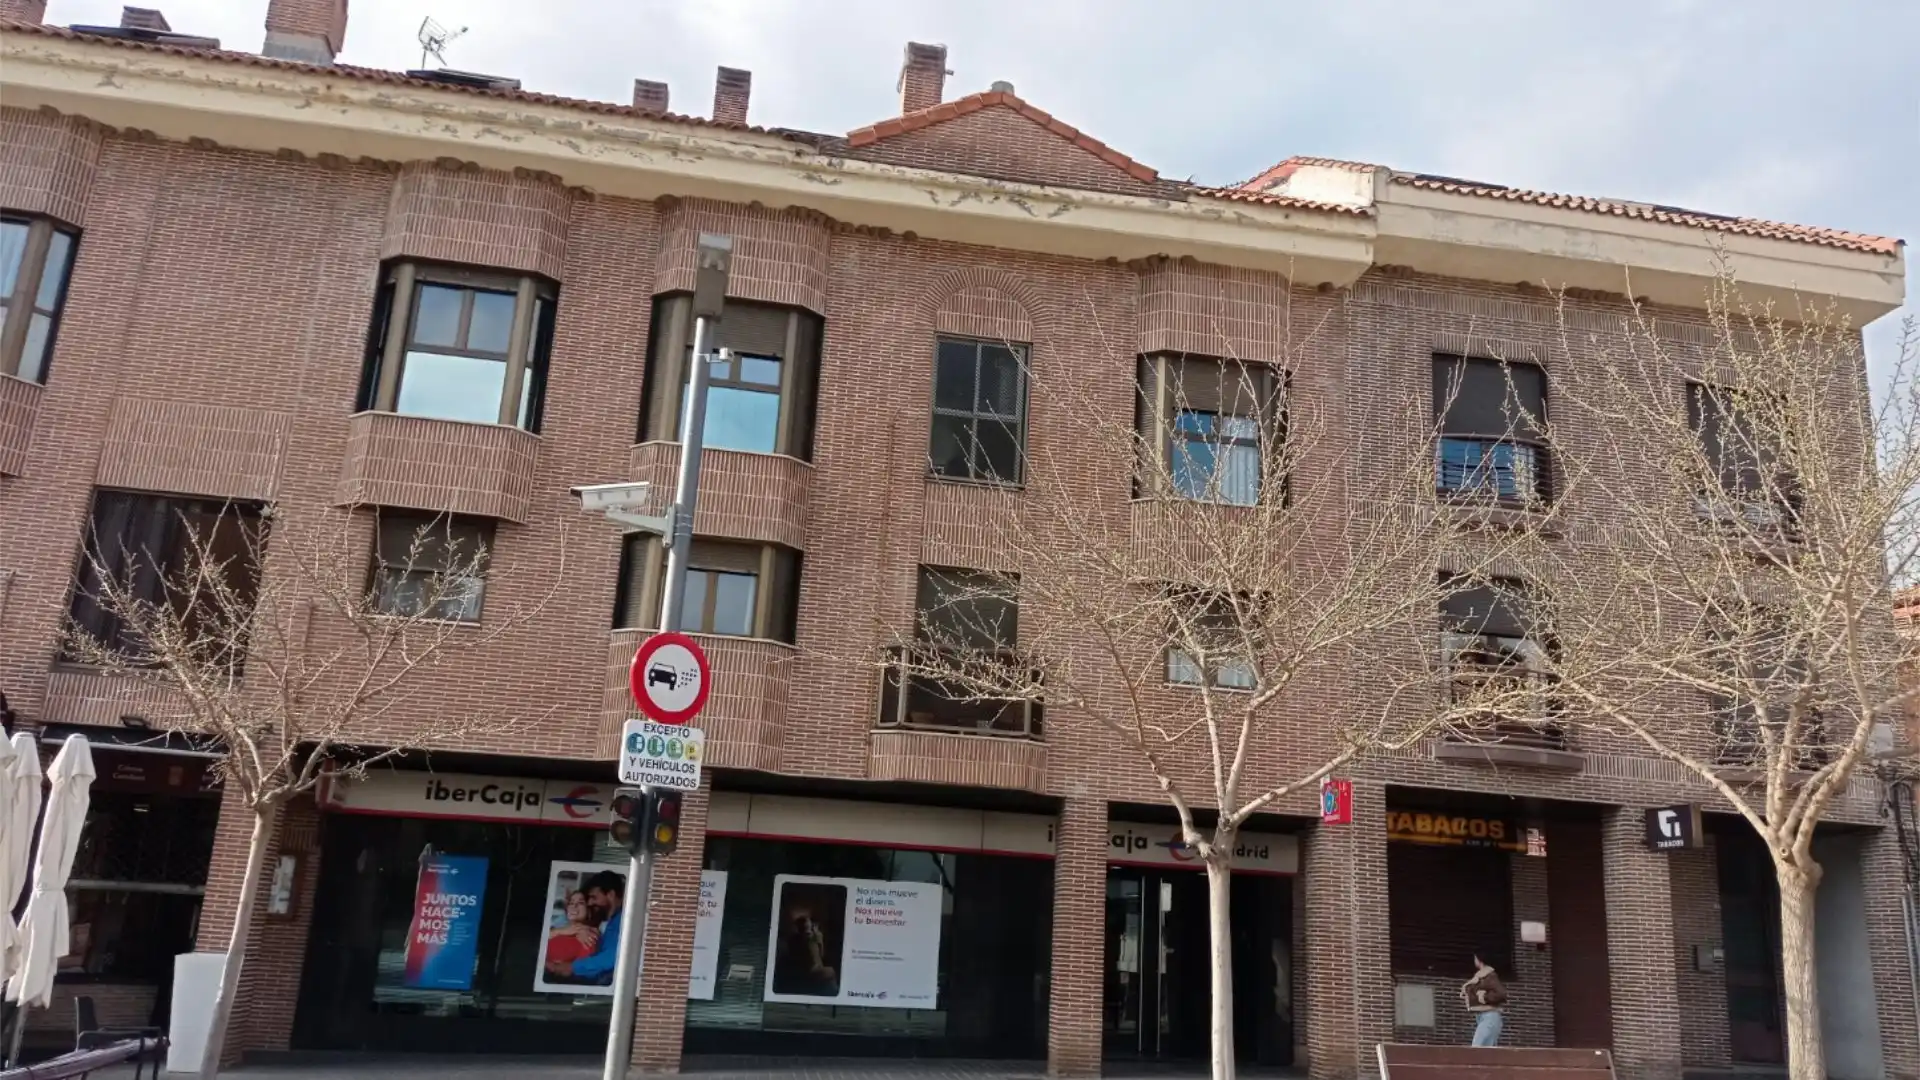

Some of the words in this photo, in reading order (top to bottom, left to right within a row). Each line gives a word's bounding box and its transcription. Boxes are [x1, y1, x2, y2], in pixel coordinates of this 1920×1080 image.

[643, 723, 690, 738] EXCEPTO
[629, 756, 637, 767] Y
[639, 757, 696, 774] VEHÍCULOS
[624, 771, 697, 788] AUTORIZADOS
[425, 780, 540, 811] iberCaja
[1386, 812, 1505, 838] TABACOS
[421, 893, 477, 906] JUNTOS
[856, 886, 869, 895] No
[888, 889, 919, 898] mueve
[421, 906, 466, 919] HACE-
[855, 906, 872, 915] Nos
[419, 918, 452, 931] MOS
[416, 930, 449, 945] MÁS
